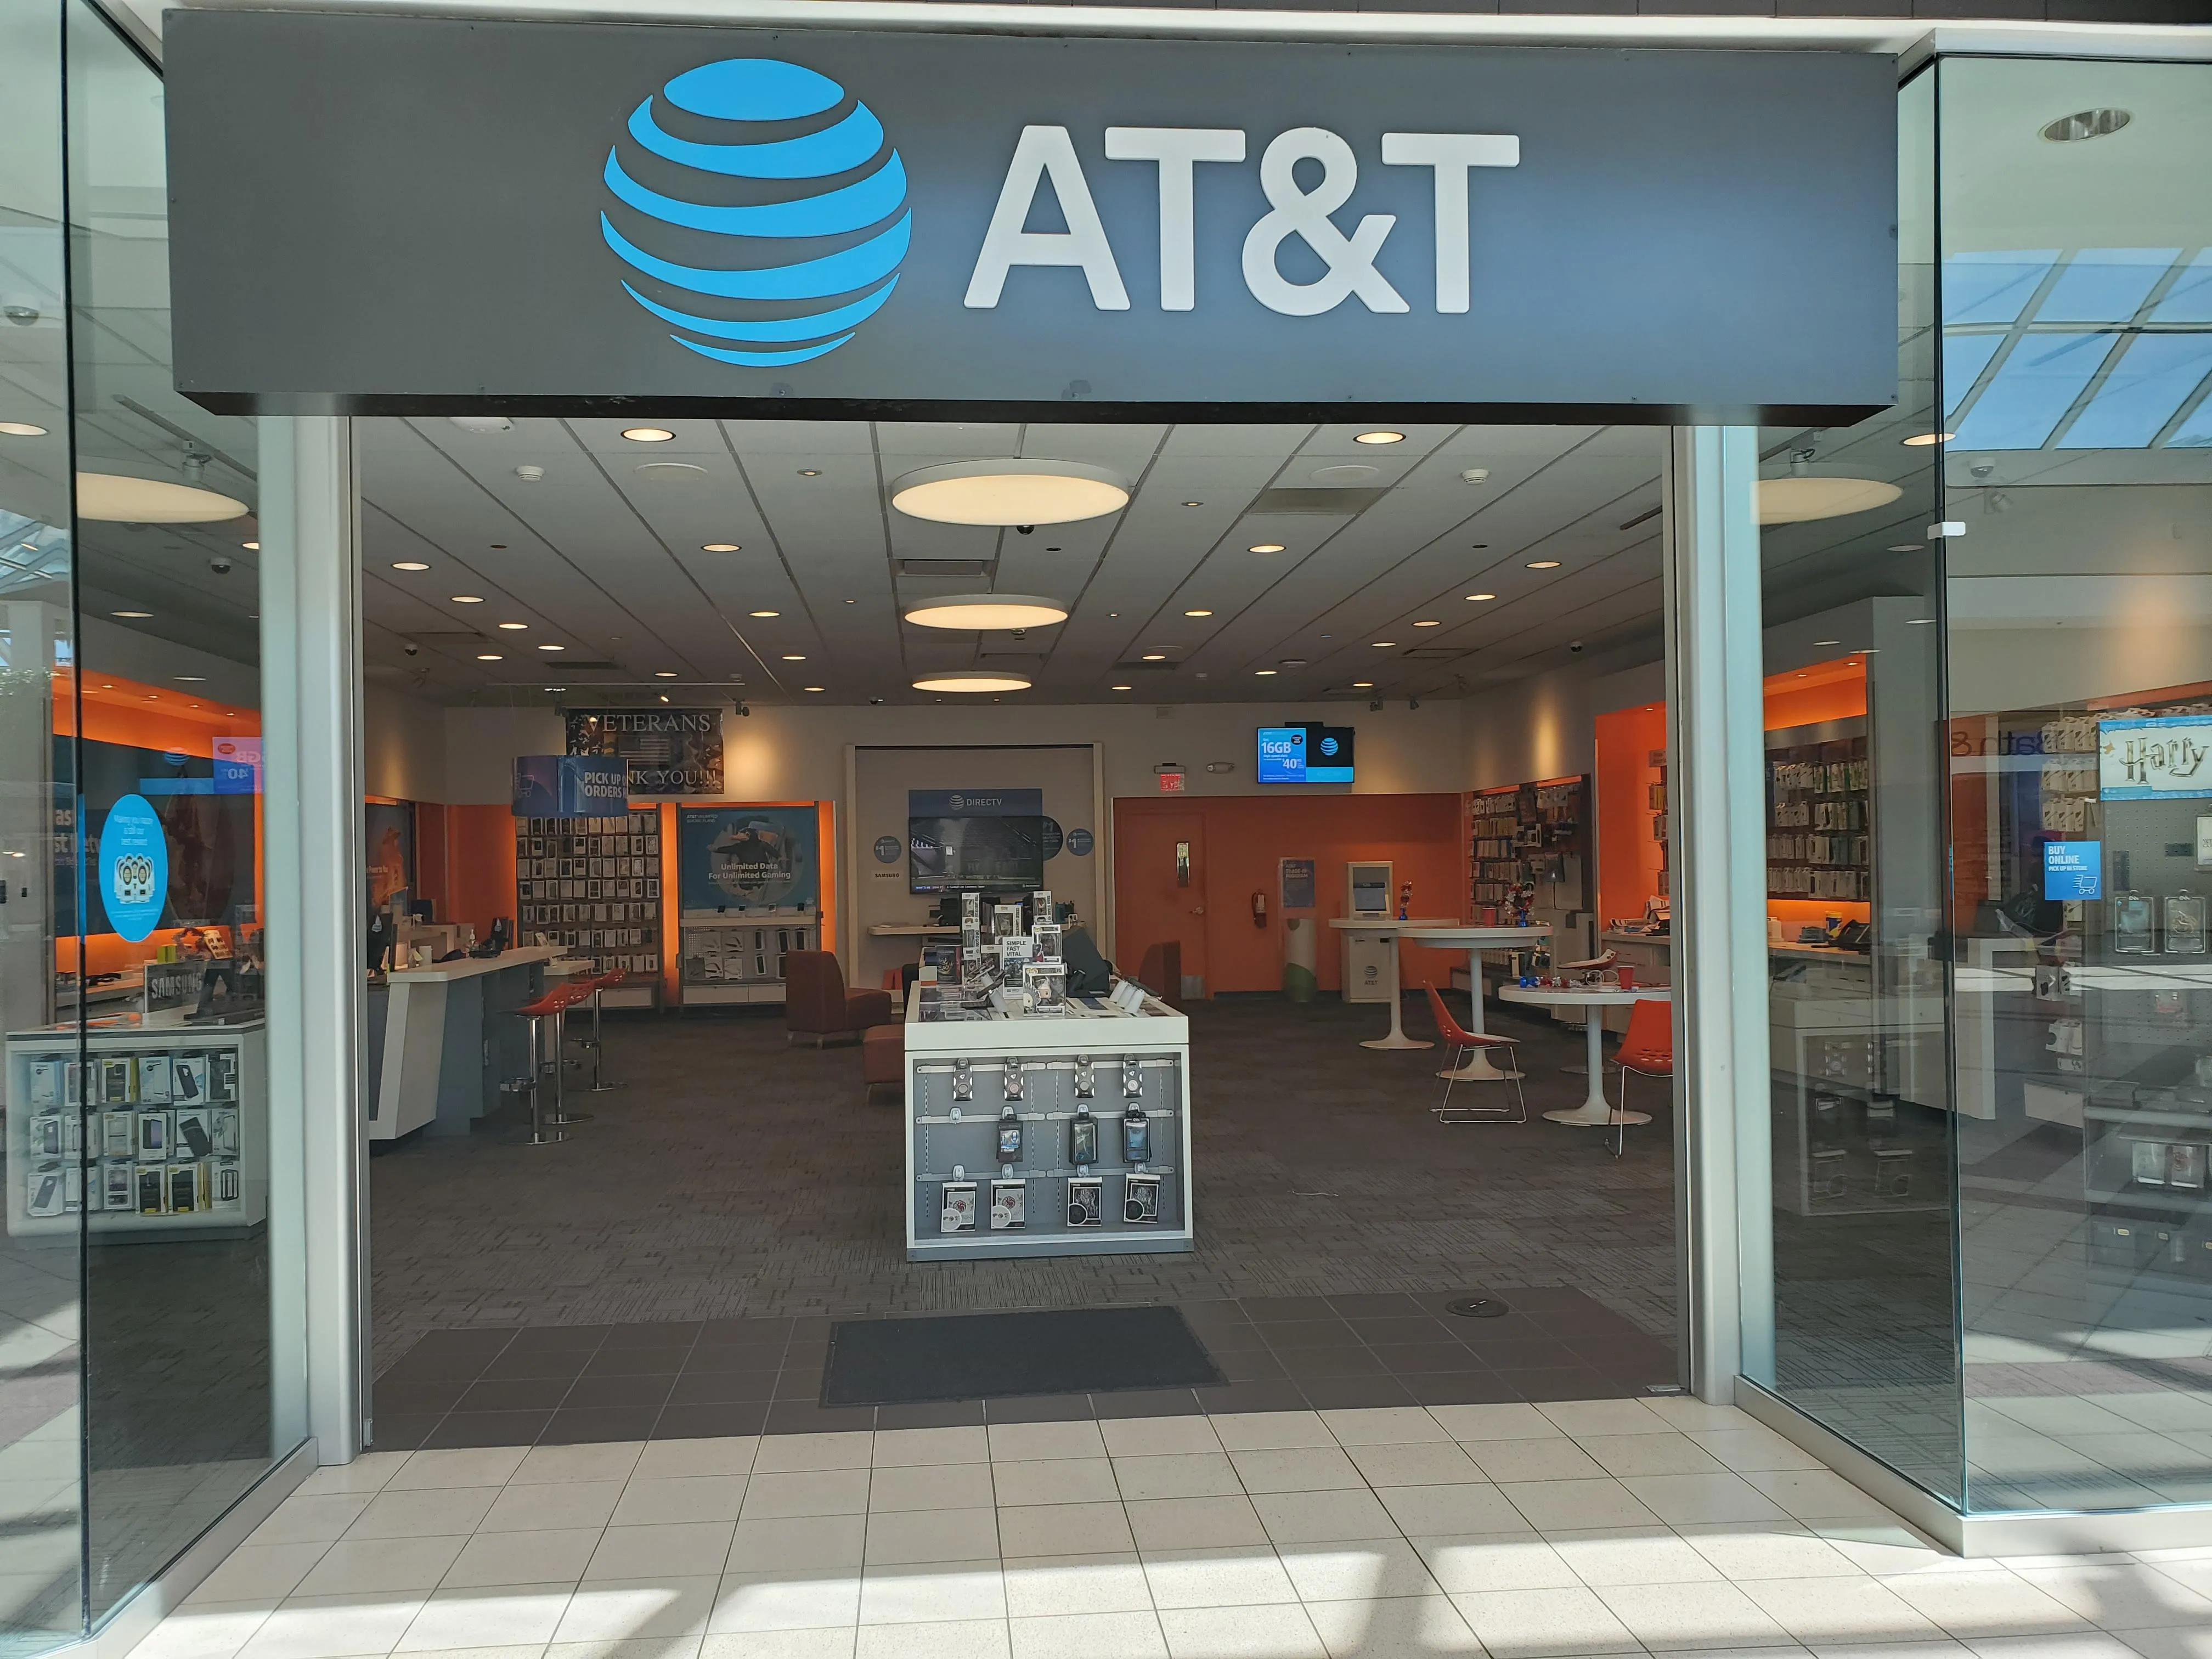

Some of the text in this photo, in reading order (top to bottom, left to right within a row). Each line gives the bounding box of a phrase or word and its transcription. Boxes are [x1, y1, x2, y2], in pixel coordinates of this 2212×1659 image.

[963, 125, 1520, 317] AT&T
[585, 714, 712, 732] VETERANS
[1261, 742, 1291, 754] 16GB
[2119, 737, 2210, 785] Harry
[584, 771, 621, 785] PICK UP
[658, 770, 716, 785] YOU!!!
[584, 785, 622, 799] ORDERS
[966, 798, 1002, 806] DIRECTV
[2048, 845, 2066, 855] BUY
[2048, 855, 2080, 865] ONLINE
[761, 871, 791, 879] Gaming
[151, 972, 202, 998] SAMSUNG
